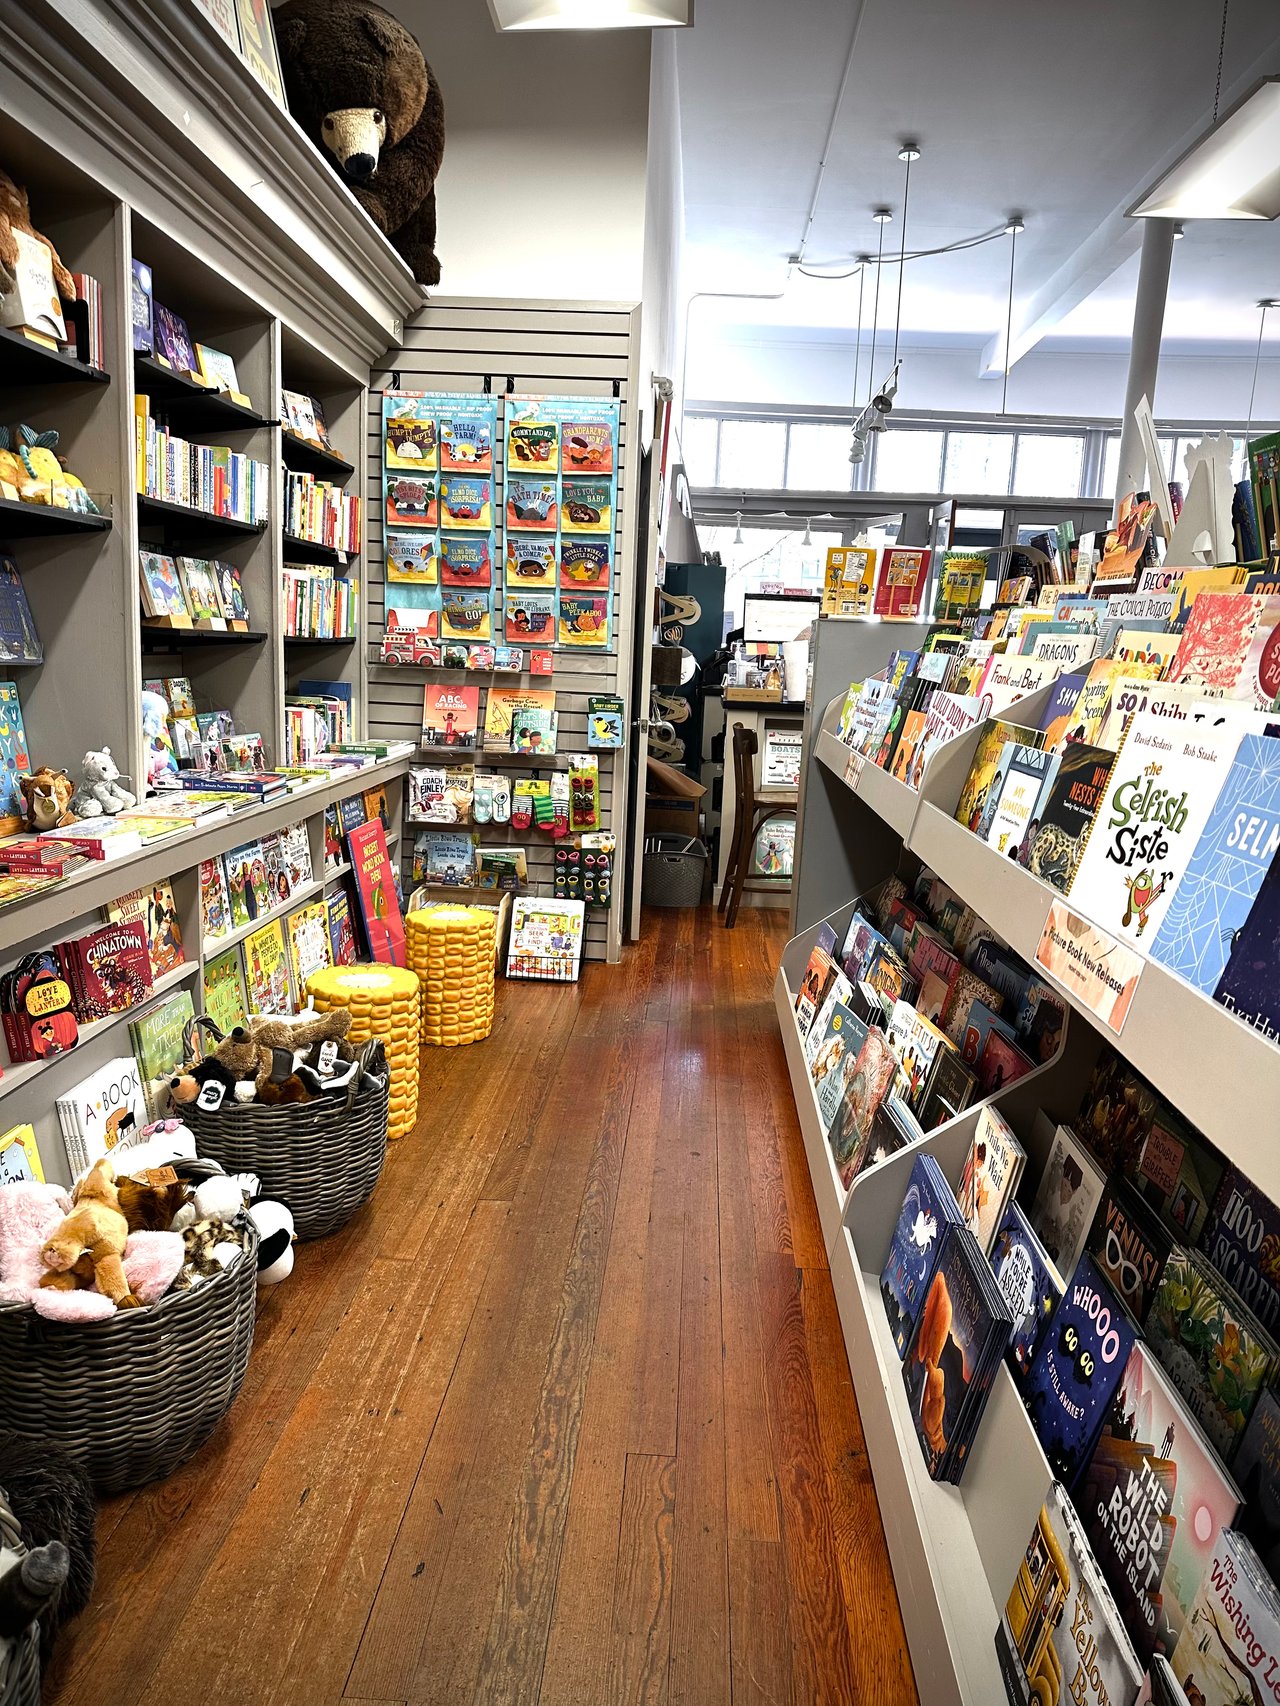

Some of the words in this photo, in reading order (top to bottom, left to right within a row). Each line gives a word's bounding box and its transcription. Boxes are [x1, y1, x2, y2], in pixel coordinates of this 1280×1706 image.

[388, 429, 413, 437] HUMPTY
[406, 429, 432, 442] DUMPTY
[454, 432, 476, 440] FARM!
[544, 430, 552, 438] ME
[563, 427, 608, 437] GRANDPARENTS
[512, 492, 530, 503] BATH
[566, 488, 581, 498] LOVE
[531, 544, 548, 553] VAMOS
[465, 610, 482, 620] GO!
[569, 608, 602, 616] PEEKABOO
[1107, 602, 1121, 617] THE
[1121, 600, 1146, 616] COUCH
[1146, 600, 1172, 618] POTATO
[1039, 644, 1079, 663] DRAGONS
[991, 664, 1012, 686] Frank
[1010, 674, 1020, 687] and
[1021, 668, 1042, 690] Bert
[1082, 678, 1110, 698] Spring
[933, 691, 948, 720] LULU
[948, 703, 974, 732] DIDN'T
[1082, 702, 1107, 721] Scent
[1117, 693, 1137, 712] SO
[927, 709, 944, 736] WANT
[1134, 733, 1150, 746] David
[1151, 736, 1172, 751] Sedaris
[1183, 744, 1196, 757] Bob
[1197, 747, 1218, 762] Staake
[421, 785, 444, 793] FINLEY
[1014, 786, 1026, 800] MY
[1069, 781, 1094, 806] NESTS
[1000, 798, 1030, 820] SOMEONE
[1108, 775, 1188, 834] Selfish
[359, 834, 368, 842] Richard
[363, 840, 378, 856] BIGGEST
[453, 835, 468, 844] Truck
[362, 857, 374, 875] WORD
[373, 852, 385, 866] BOOK
[370, 871, 382, 884] EVER!
[121, 903, 139, 919] SWEET
[96, 930, 121, 944] WELCOME
[259, 937, 270, 949] WHAT
[87, 936, 142, 964] CHINATOWN
[262, 946, 274, 958] PEOPLE
[1049, 925, 1066, 950] Picture
[1066, 940, 1083, 962] Book
[1082, 952, 1095, 972] New
[1096, 960, 1125, 997] Releases
[37, 985, 58, 998] LOVE
[211, 986, 234, 1010] WELCOME
[34, 997, 66, 1013] LANTERN
[801, 1004, 811, 1020] MARCH
[1221, 991, 1252, 1025] TAKE
[146, 1012, 170, 1038] MORE
[172, 1005, 185, 1015] THAN
[798, 1017, 807, 1036] HOPE
[889, 1020, 903, 1036] Leave
[911, 1020, 923, 1036] LET
[921, 1030, 929, 1042] IT
[156, 1024, 182, 1049] TREE
[85, 1104, 96, 1125] A
[102, 1069, 139, 1111] BOOK
[985, 1122, 1000, 1155] While
[1000, 1147, 1009, 1169] We
[1153, 1135, 1177, 1166] TROUBLE
[988, 1155, 1004, 1191] Wait
[1143, 1156, 1174, 1191] GIRAFFES
[1222, 1188, 1264, 1253] TOO
[1105, 1199, 1160, 1292] VENUS!
[1014, 1246, 1032, 1277] WHILE
[1011, 1261, 1028, 1294] YOU'RE
[1001, 1268, 1023, 1319] ASLEEP
[1073, 1284, 1119, 1364] WHOOO
[1047, 1348, 1054, 1363] IS
[1048, 1365, 1061, 1396] STILL
[1167, 1367, 1186, 1395] ARE
[1187, 1385, 1206, 1421] THE
[1060, 1392, 1085, 1422] AWAKE?
[1141, 1456, 1166, 1517] THE
[1127, 1471, 1164, 1551] WILD
[1109, 1485, 1160, 1588] ROBOT
[1097, 1501, 1109, 1529] ON
[1109, 1523, 1128, 1563] THE
[1127, 1561, 1155, 1627] ISLAND
[1224, 1555, 1238, 1584] The
[1078, 1579, 1095, 1624] The
[1210, 1558, 1267, 1666] Wishing
